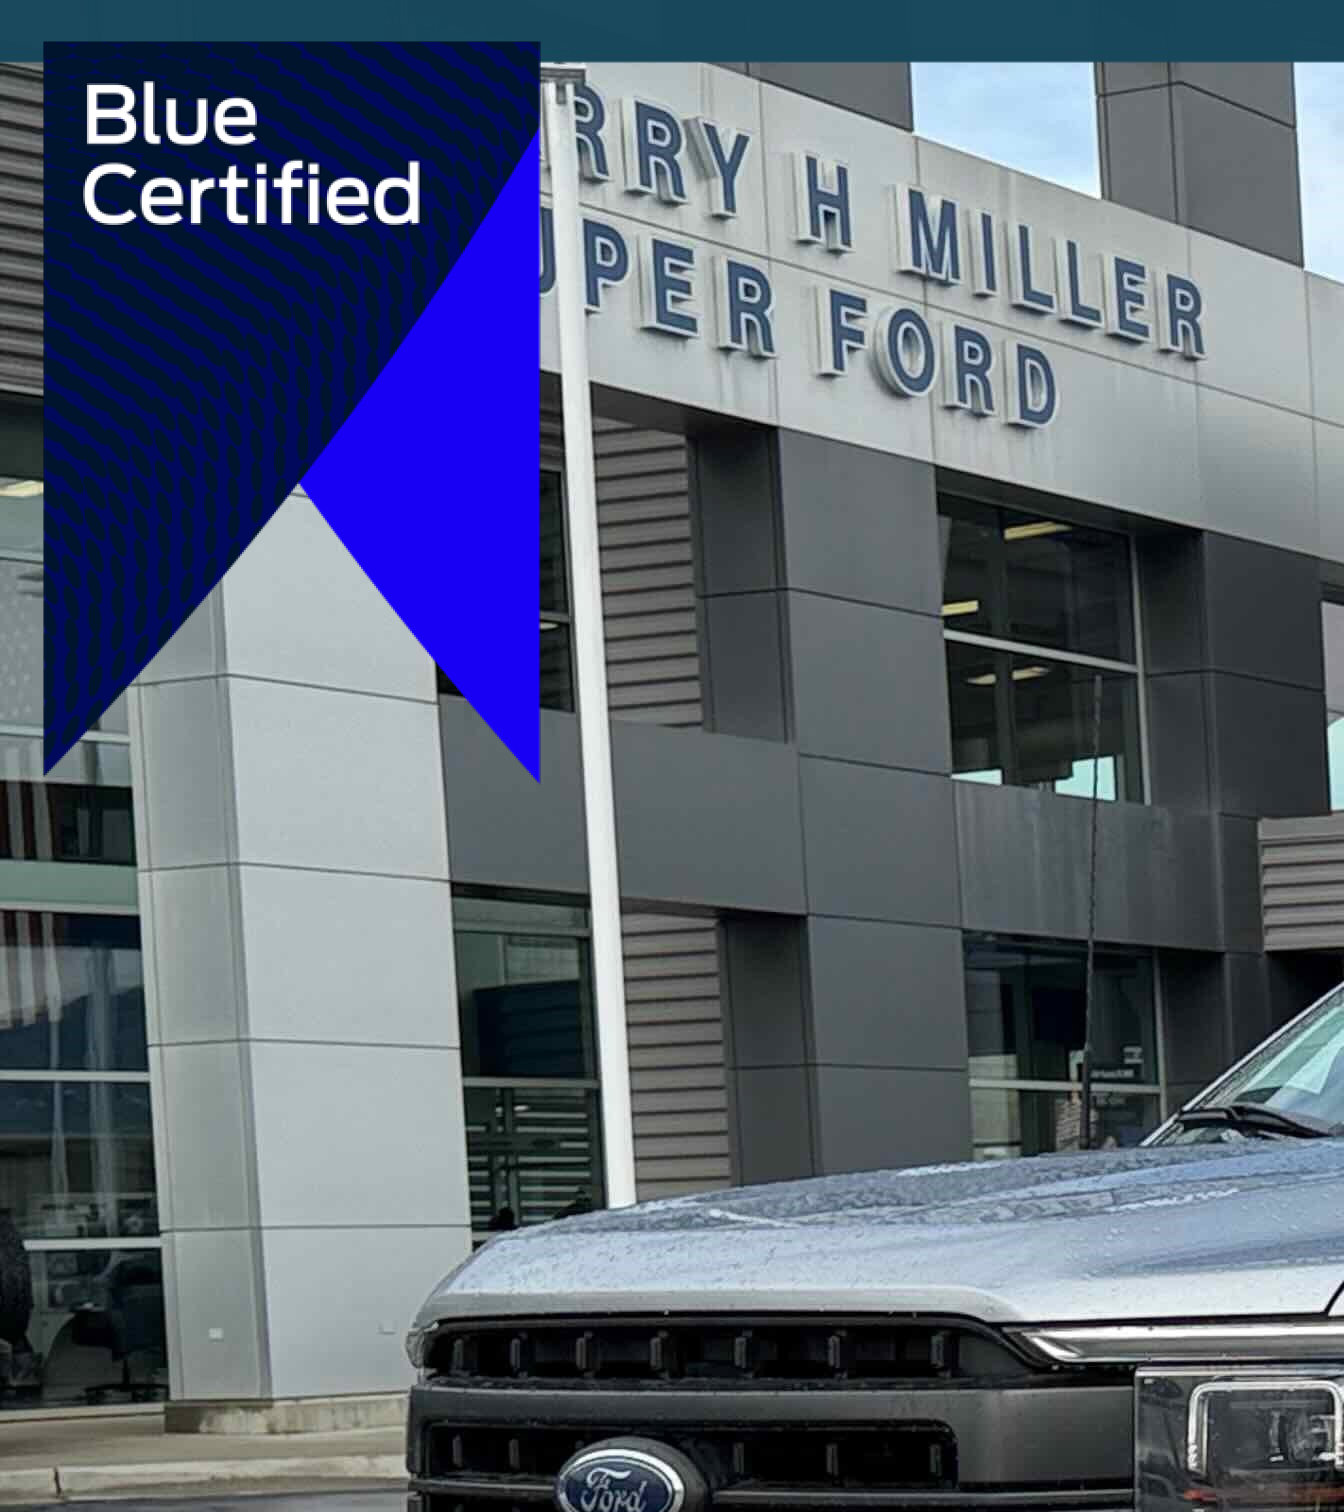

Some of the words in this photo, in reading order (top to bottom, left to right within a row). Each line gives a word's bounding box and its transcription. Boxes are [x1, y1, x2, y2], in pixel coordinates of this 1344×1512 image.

[574, 82, 750, 218] RRY
[799, 152, 854, 255] H
[900, 185, 1207, 360] MILLER
[822, 285, 1058, 428] FORD
